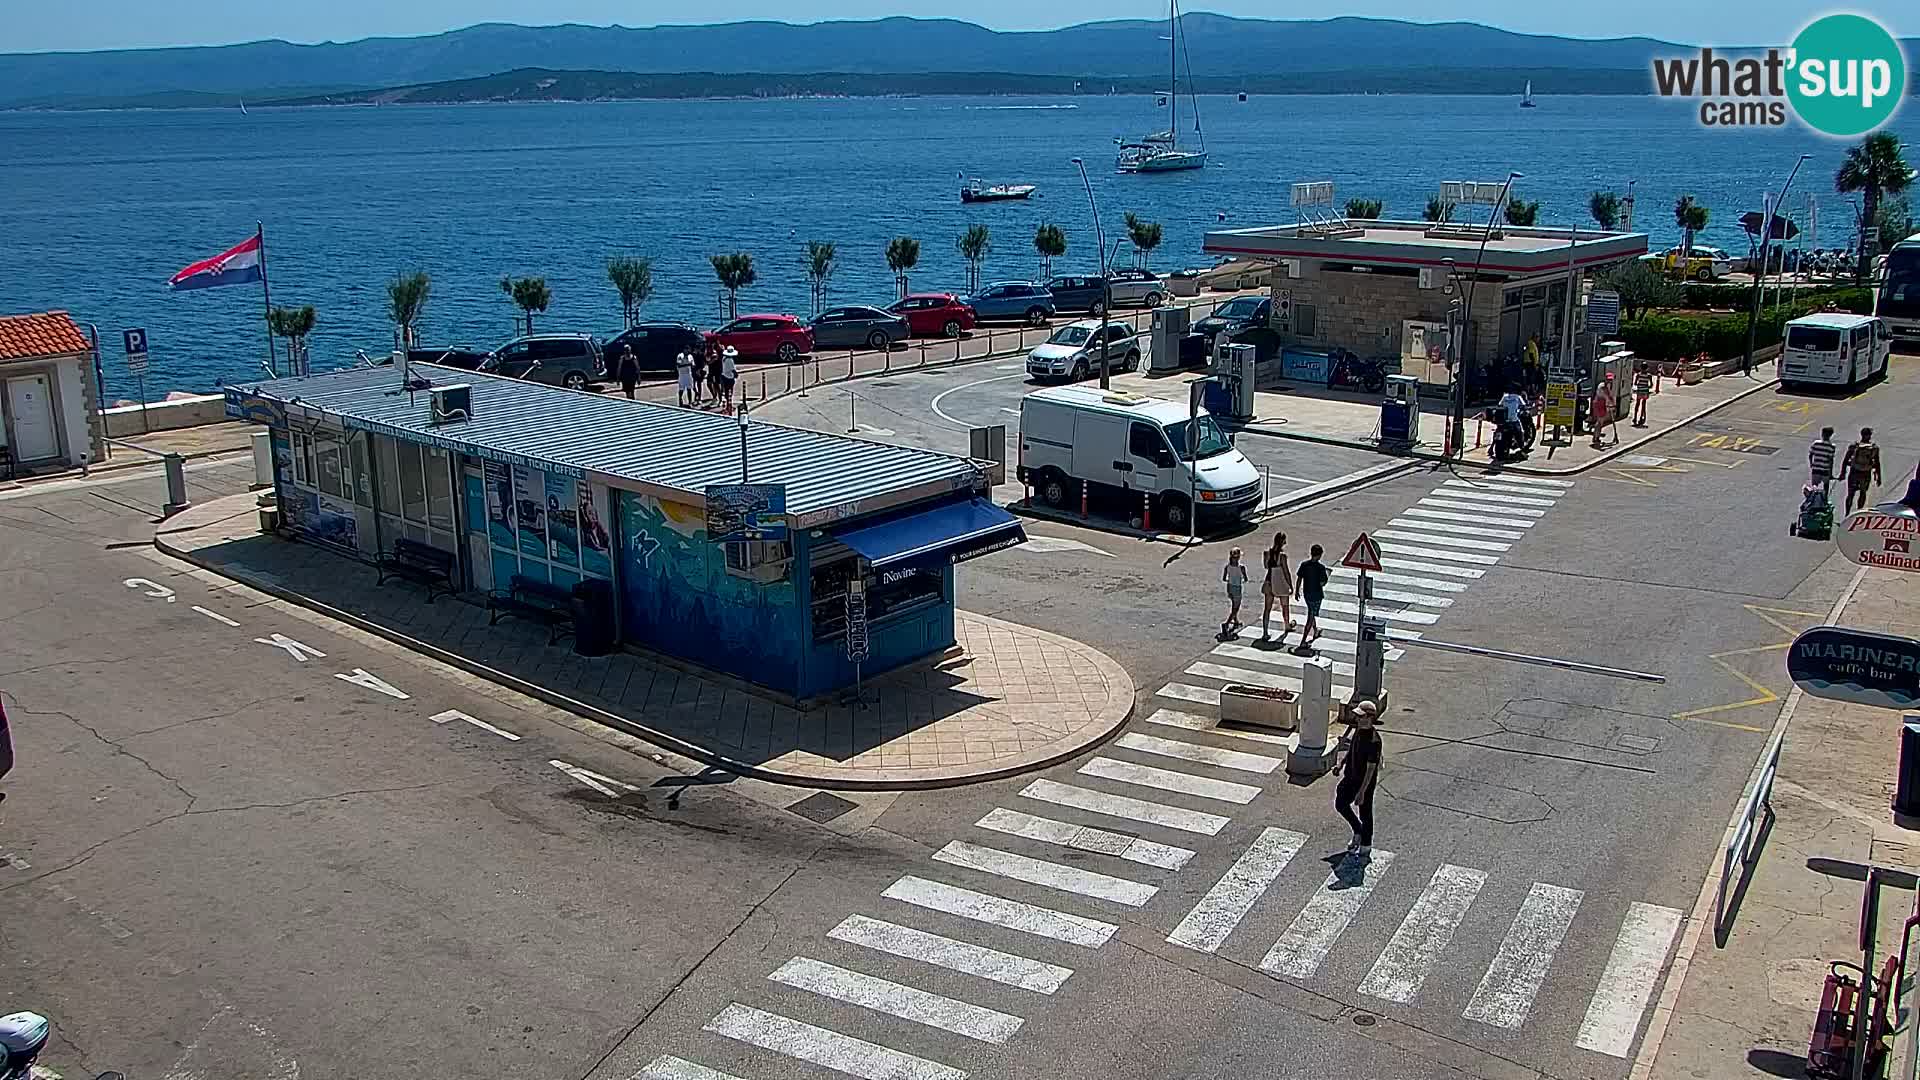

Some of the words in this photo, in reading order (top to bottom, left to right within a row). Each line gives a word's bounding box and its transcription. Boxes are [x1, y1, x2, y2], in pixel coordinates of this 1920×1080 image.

[128, 332, 141, 351] P
[435, 438, 467, 452] POSTAJA
[477, 446, 492, 458] BUS
[494, 451, 525, 465] STATION
[527, 457, 553, 472] TICKET
[554, 463, 582, 478] OFFICE
[1848, 515, 1920, 534] PIZZE
[1881, 530, 1917, 541] GRILL
[1870, 666, 1897, 680] bar
